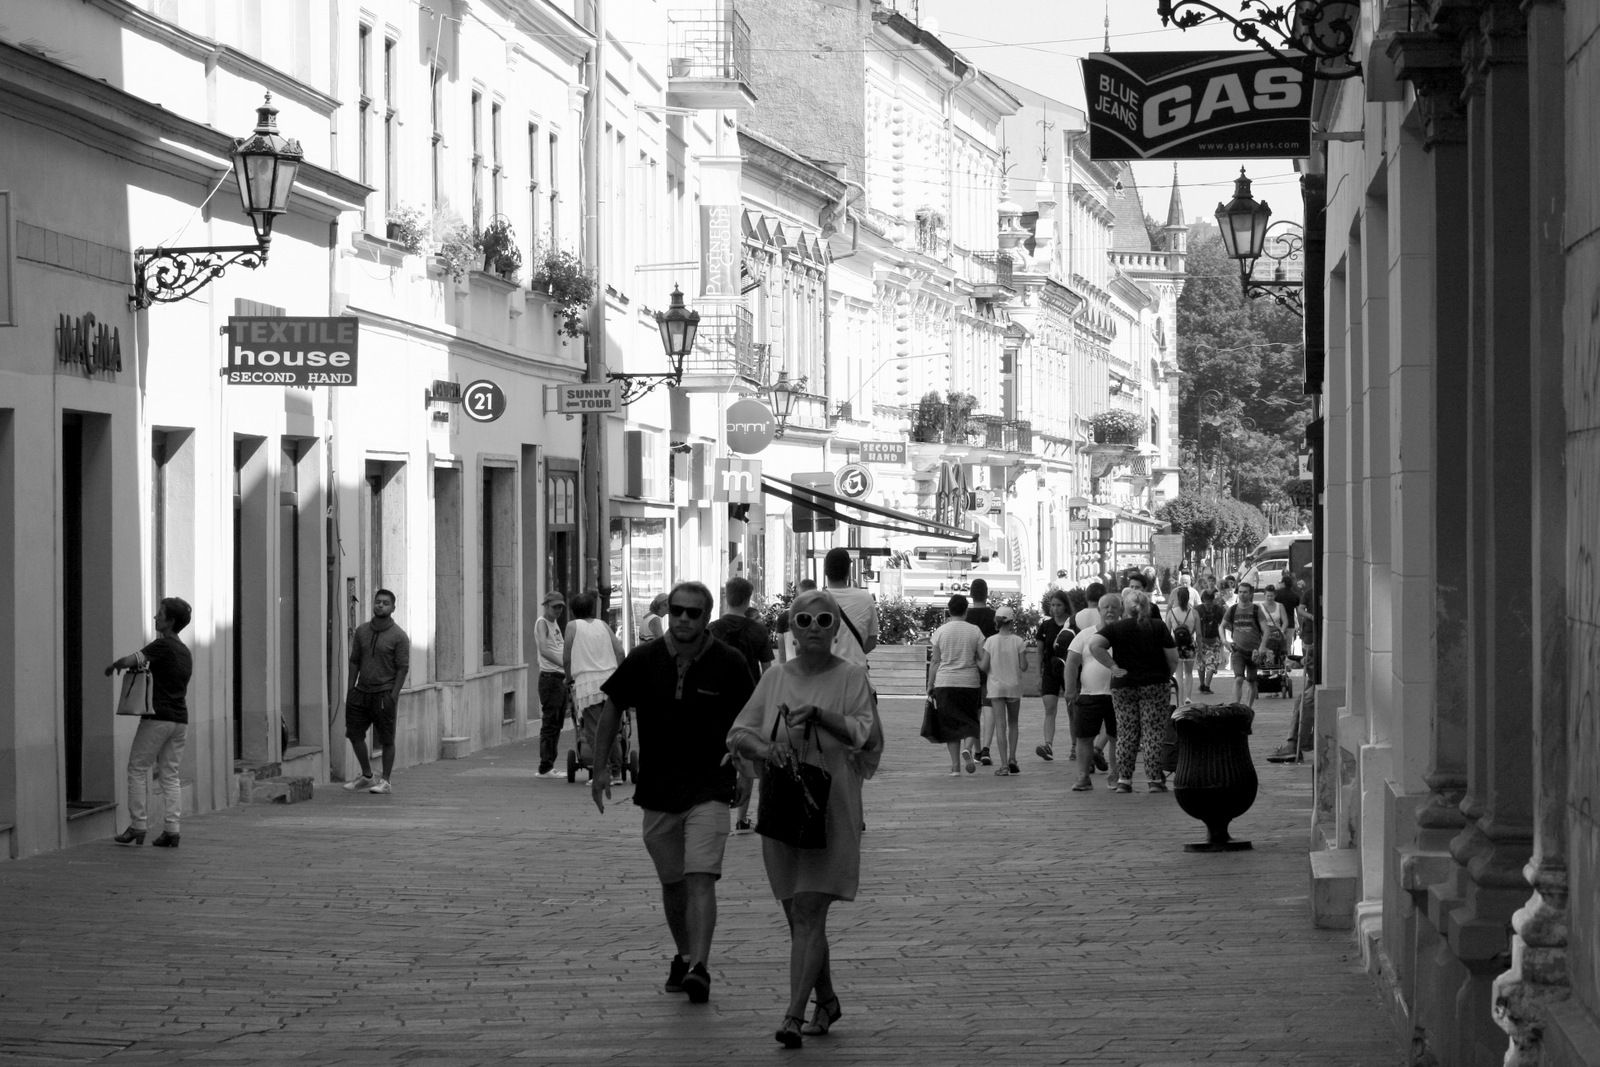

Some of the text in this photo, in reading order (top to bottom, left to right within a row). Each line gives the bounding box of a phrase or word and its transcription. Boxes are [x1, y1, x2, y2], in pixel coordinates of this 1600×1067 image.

[1099, 73, 1140, 112] BLUE
[1142, 66, 1304, 139] GAS
[1094, 95, 1138, 132] JEANS
[1198, 140, 1300, 152] www.gasjeans.com
[705, 207, 722, 295] PARTNERS
[58, 311, 122, 375] MAGMA
[230, 321, 354, 344] TEXTILE
[234, 346, 351, 367] house
[230, 371, 353, 385] SECOND HAND
[566, 389, 611, 399] SUNNY
[579, 399, 612, 409] TOUR
[862, 443, 903, 453] SECOND
[868, 453, 898, 462] HAND
[721, 470, 755, 492] m
